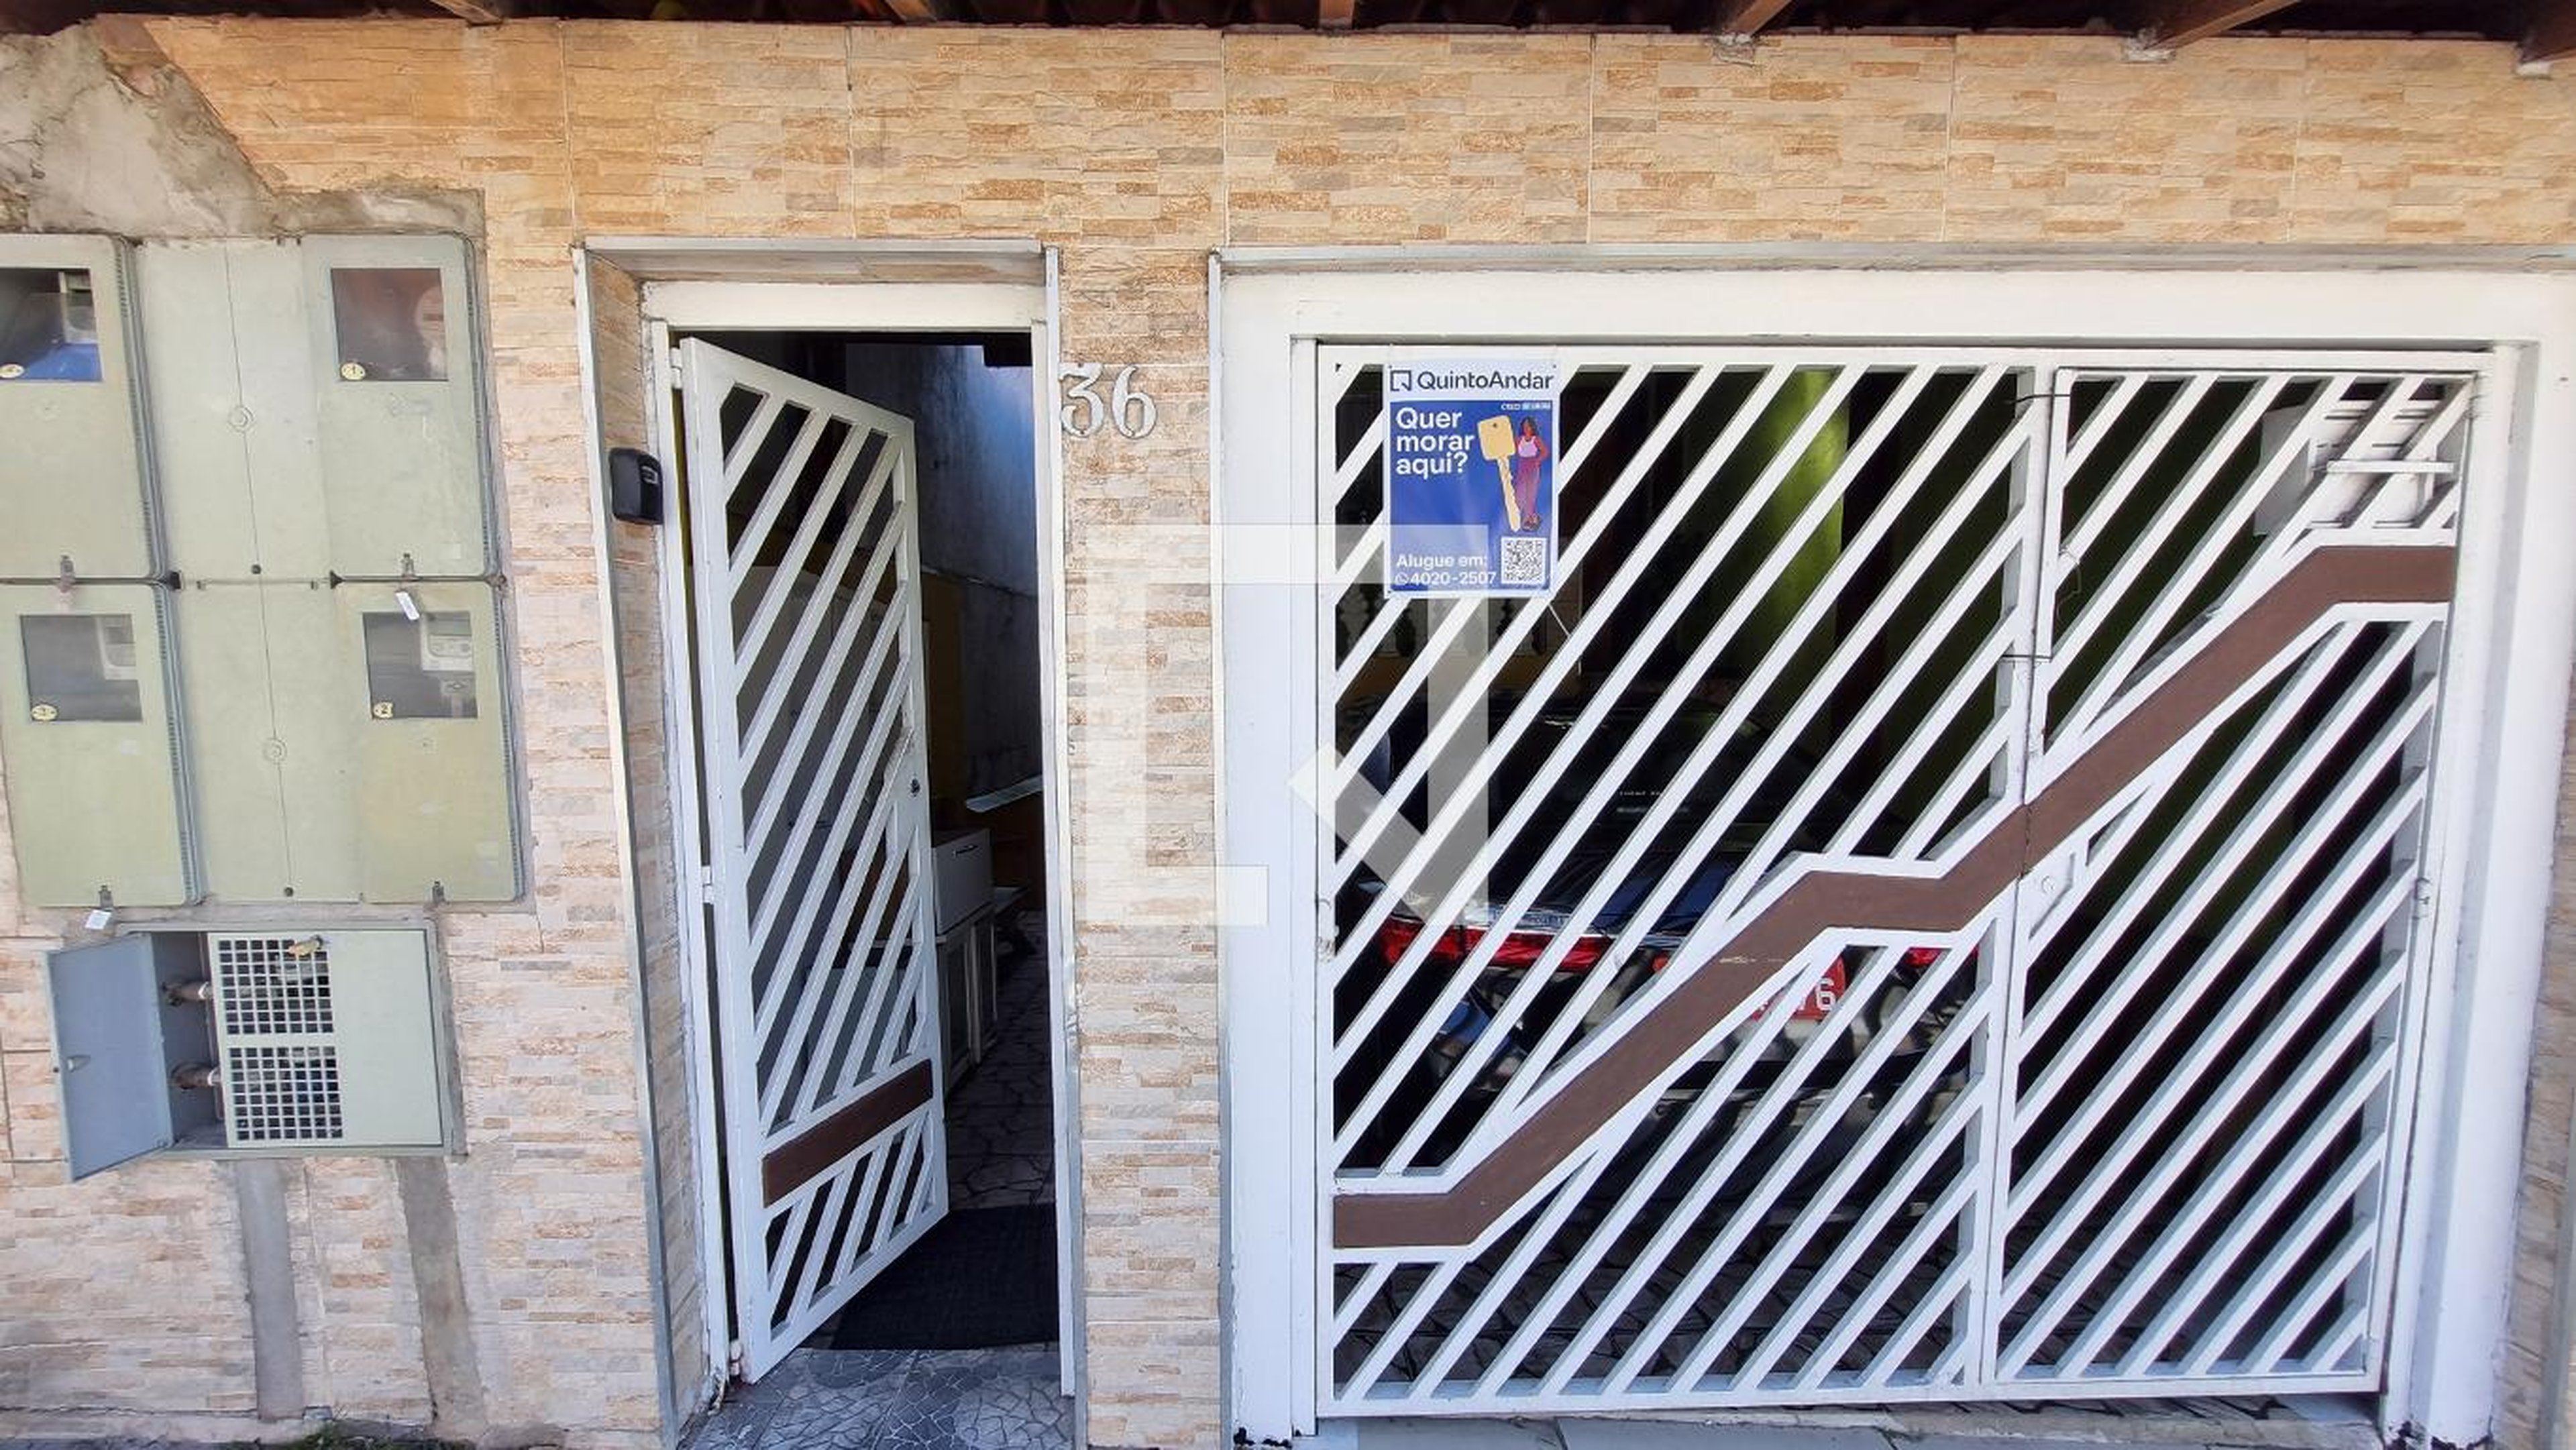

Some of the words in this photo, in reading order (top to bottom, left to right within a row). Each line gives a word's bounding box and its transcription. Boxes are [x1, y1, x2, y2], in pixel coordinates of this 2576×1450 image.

[1417, 370, 1554, 390] QuintoAndar
[1059, 361, 1158, 439] 36
[1395, 406, 1462, 429] Quer
[1395, 435, 1474, 452] morar
[1395, 452, 1468, 479] aqui?
[1396, 553, 1454, 570] Alugue
[1458, 557, 1488, 567] em:
[1412, 572, 1497, 585] 4020-2507
